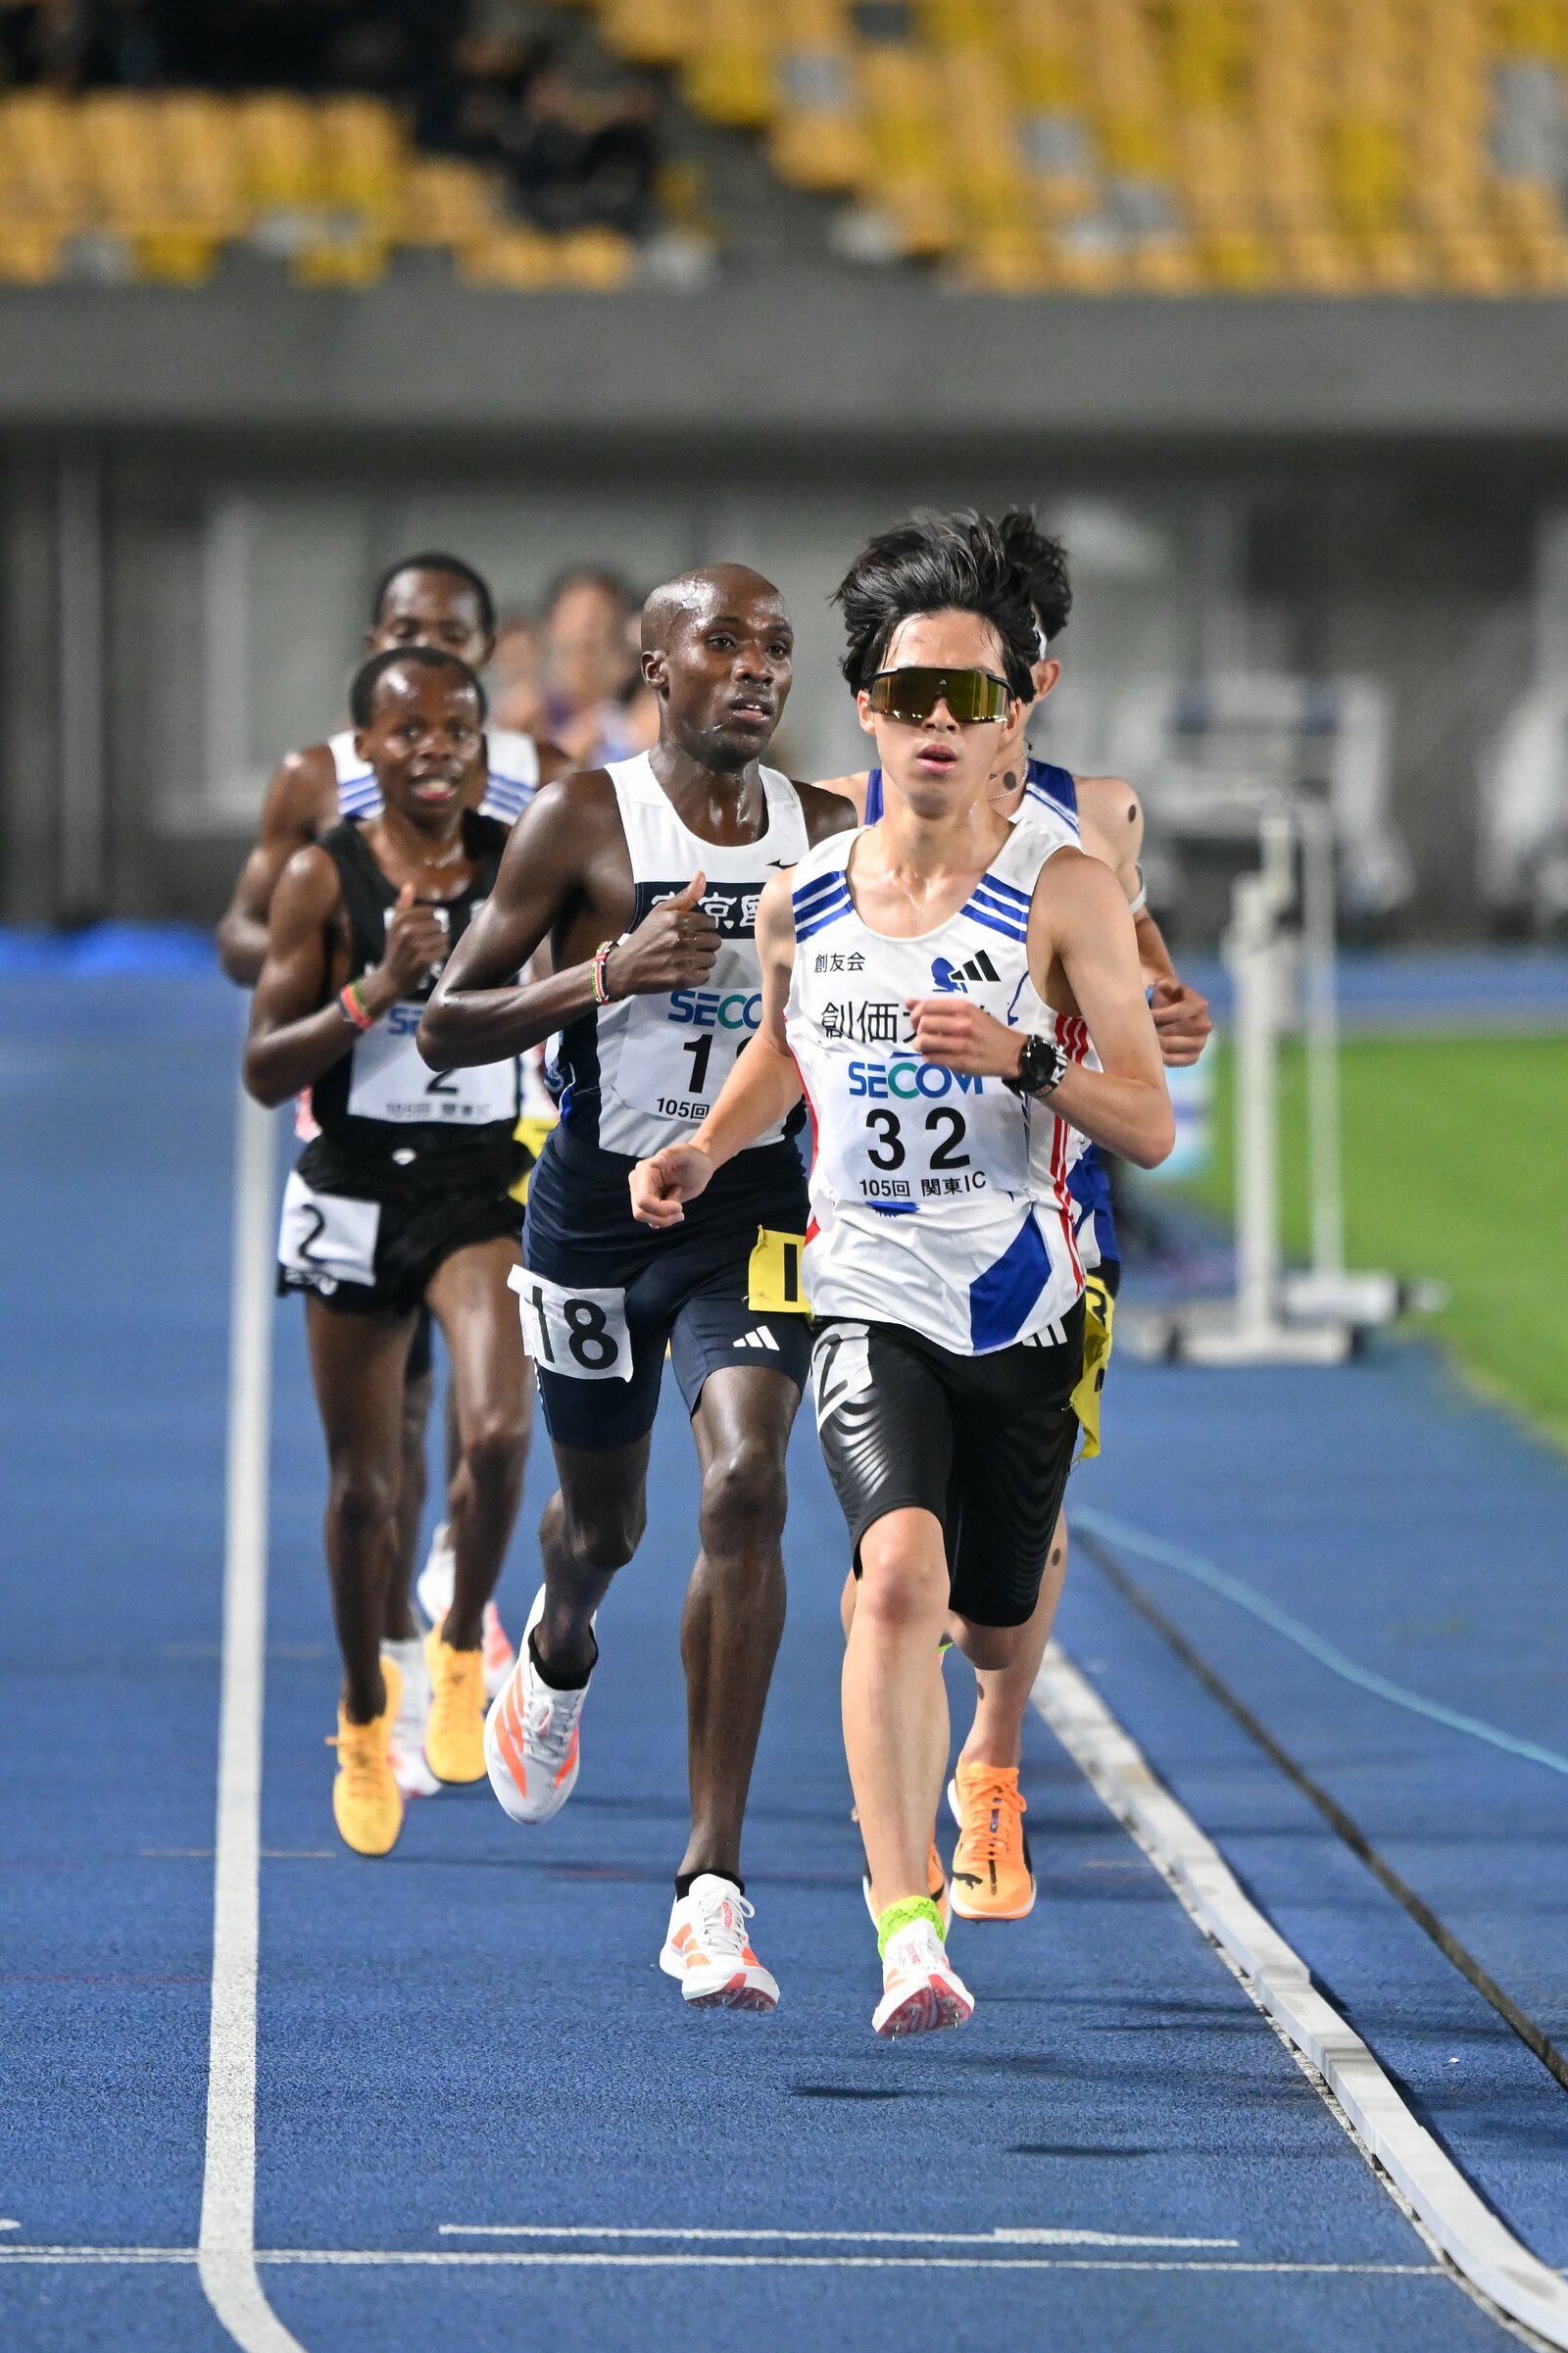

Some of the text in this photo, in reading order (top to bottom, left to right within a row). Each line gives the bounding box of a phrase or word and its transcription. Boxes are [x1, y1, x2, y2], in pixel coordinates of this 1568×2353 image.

[814, 952, 865, 973] 創友会
[668, 990, 762, 1029] SECO
[683, 1034, 753, 1094] 1
[865, 1106, 970, 1171] 32
[859, 1171, 986, 1197] 105回 関東IC
[532, 1286, 618, 1370] 18
